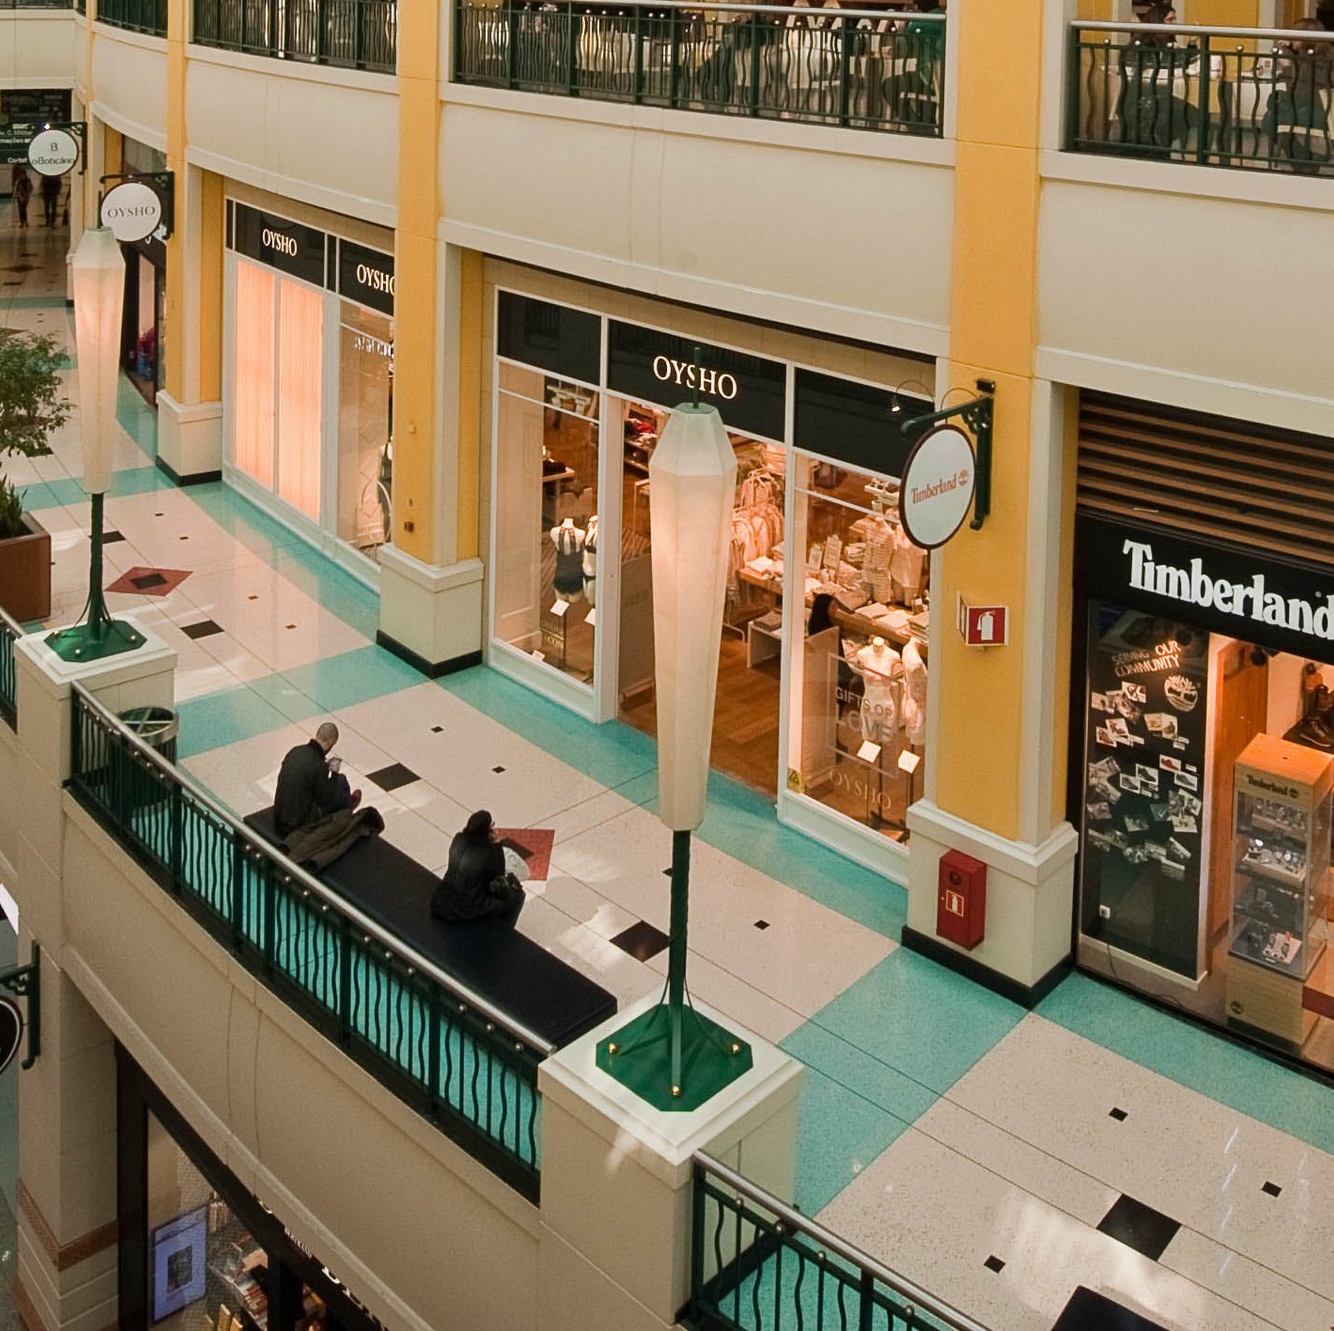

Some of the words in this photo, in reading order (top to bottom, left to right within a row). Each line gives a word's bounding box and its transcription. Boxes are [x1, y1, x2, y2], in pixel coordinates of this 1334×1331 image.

[107, 205, 156, 219] OYSHO
[262, 228, 298, 257] OYSHO
[653, 355, 738, 400] OYSHO
[911, 473, 957, 505] Timberland
[1154, 639, 1182, 656] OUR
[1114, 653, 1180, 678] COMMUNITY
[834, 686, 872, 711] GIFTS
